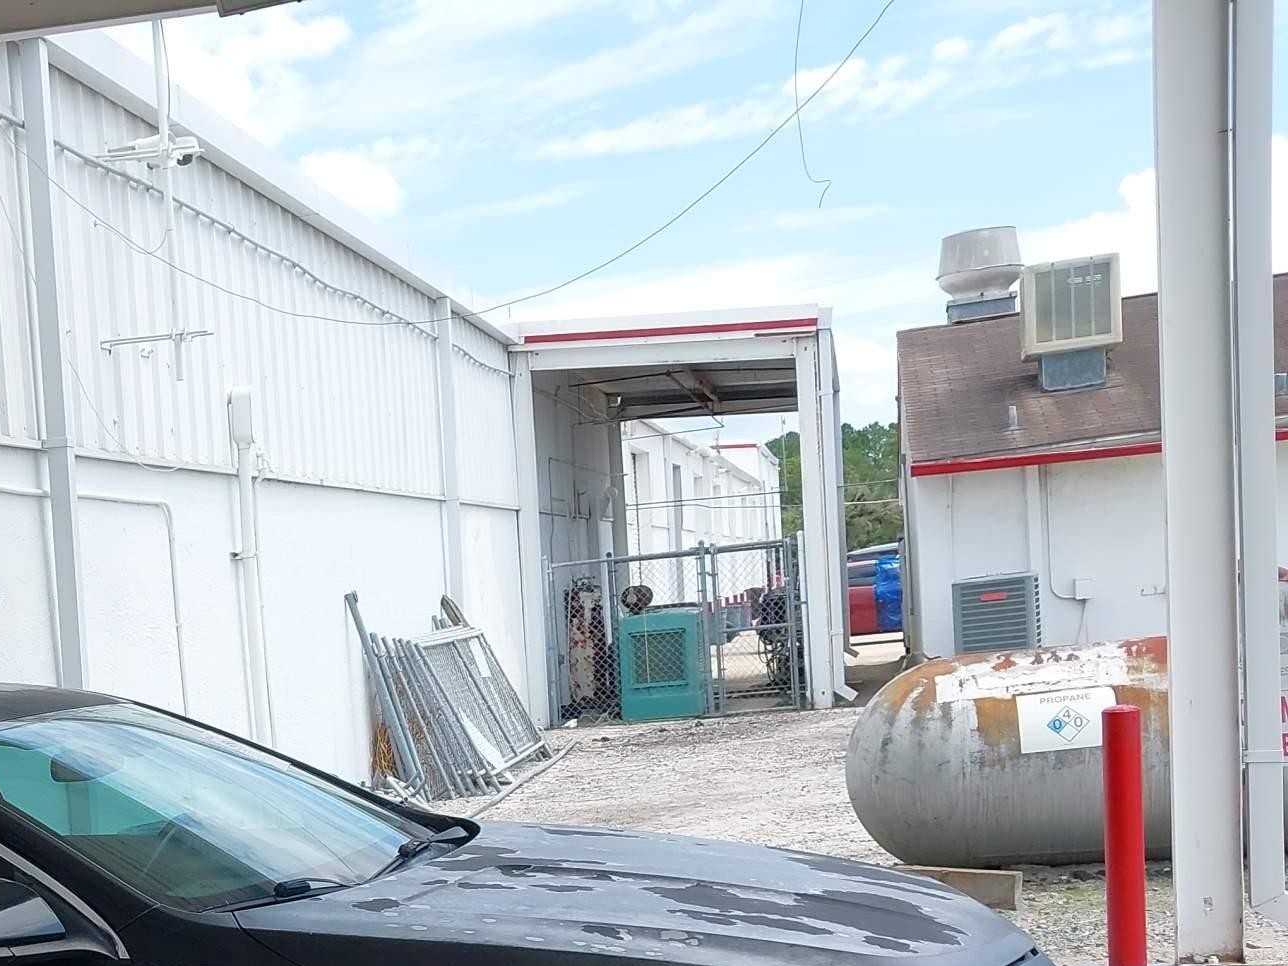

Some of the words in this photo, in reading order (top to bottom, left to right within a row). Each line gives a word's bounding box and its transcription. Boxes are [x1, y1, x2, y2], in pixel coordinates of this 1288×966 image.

[1039, 692, 1092, 704] PROPANE
[1062, 709, 1071, 719] 4
[1052, 718, 1062, 730] 0
[1074, 716, 1083, 727] 0
